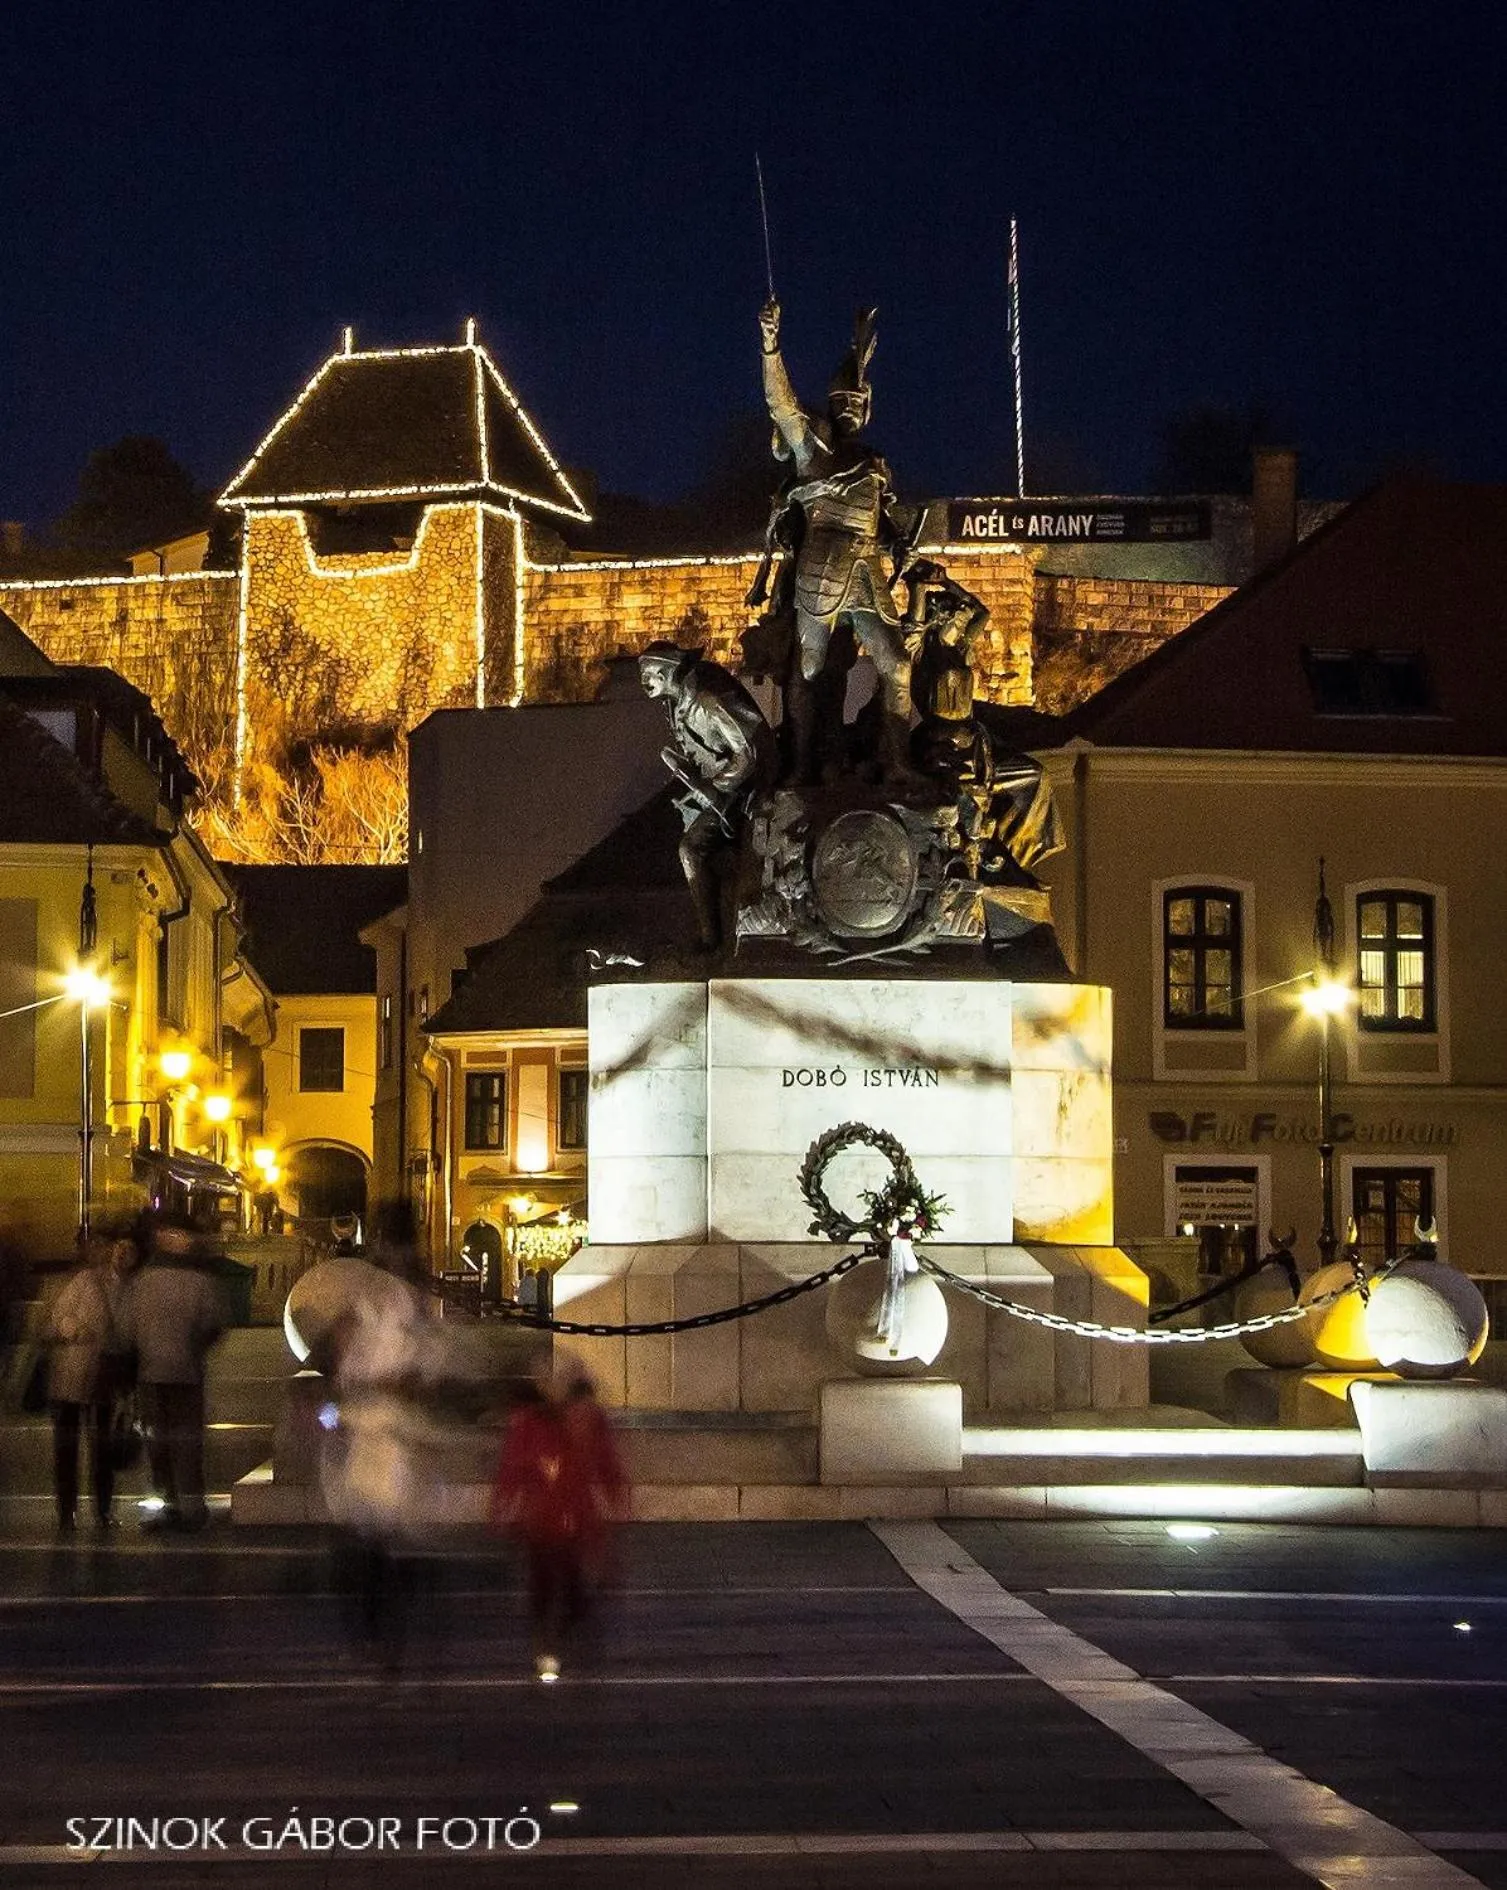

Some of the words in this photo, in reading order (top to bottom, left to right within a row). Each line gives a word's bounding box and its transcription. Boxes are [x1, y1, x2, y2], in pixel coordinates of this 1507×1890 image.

[962, 509, 1009, 537] ACÉL
[1028, 514, 1093, 537] ARANY
[782, 1064, 847, 1087] DOBÓ
[864, 1065, 939, 1087] ISTVÁN
